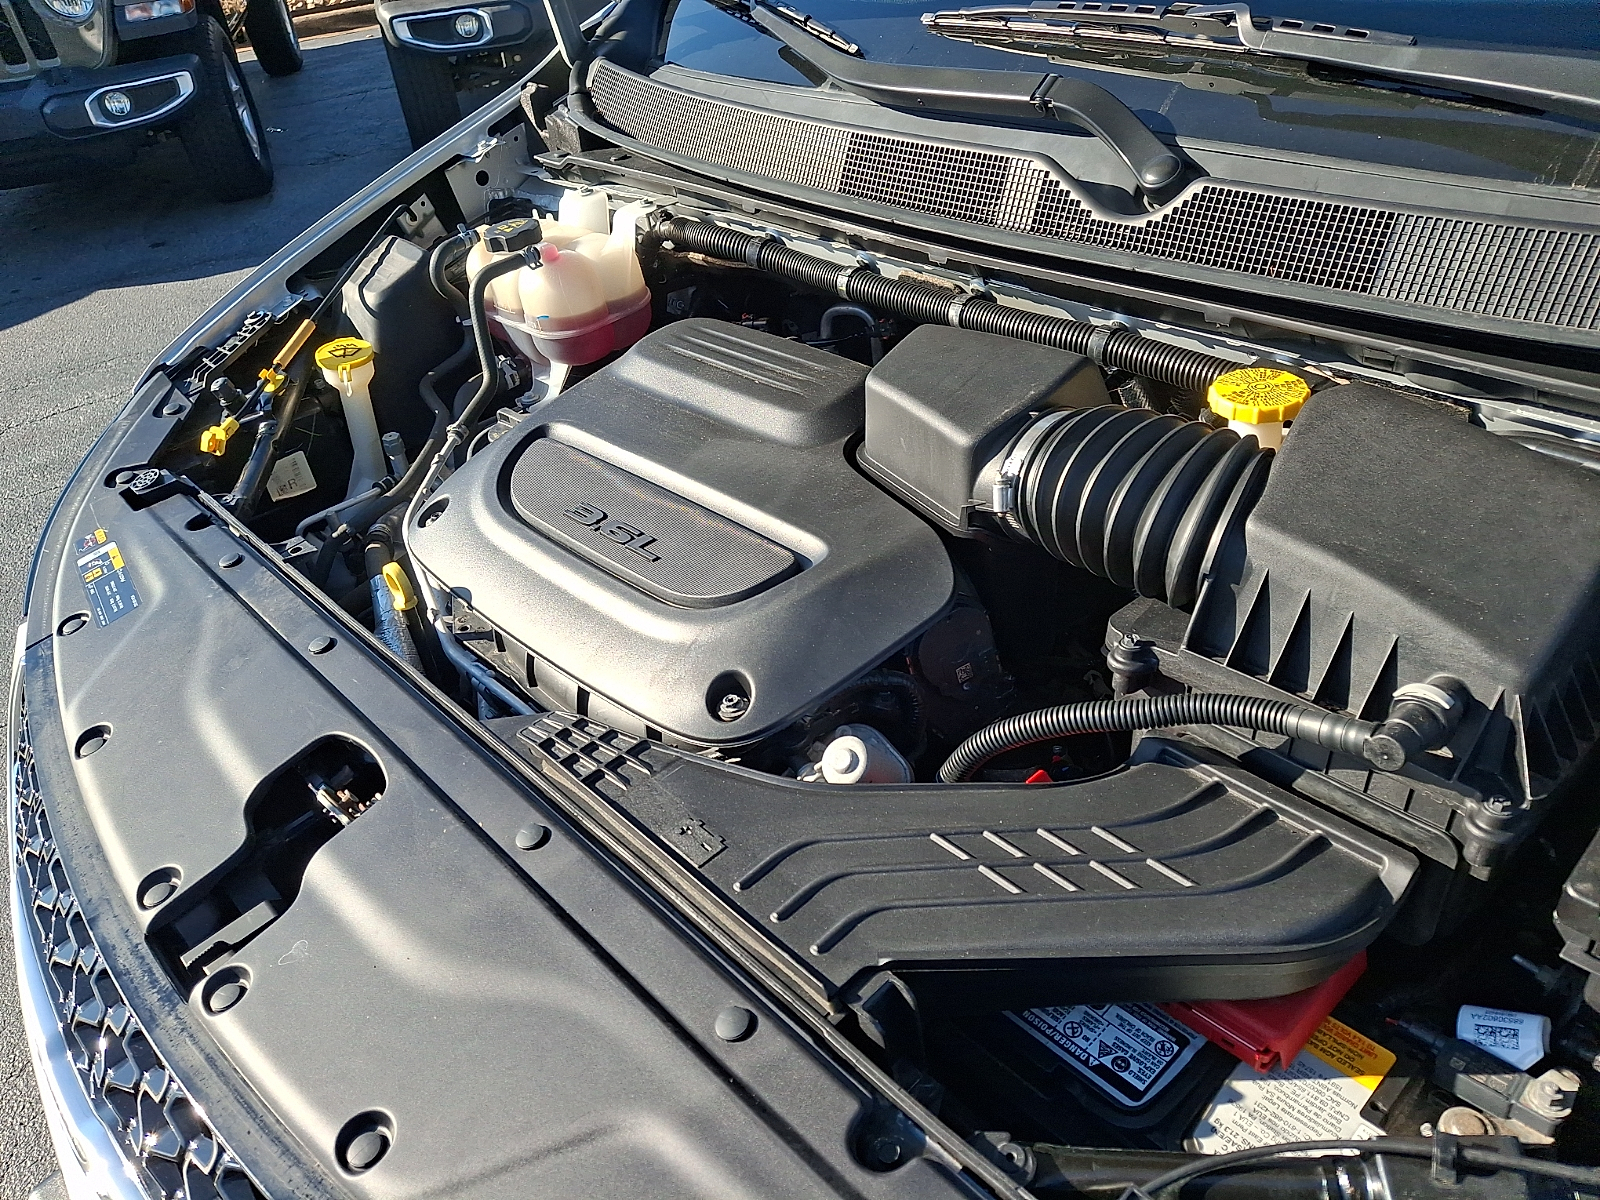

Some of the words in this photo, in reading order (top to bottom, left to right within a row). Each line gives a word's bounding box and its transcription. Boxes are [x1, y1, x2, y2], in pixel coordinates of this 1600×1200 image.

[563, 501, 661, 563] 3.6L
[1021, 1009, 1088, 1060] DANGER/POISON
[1336, 1056, 1365, 1076] SEALED
